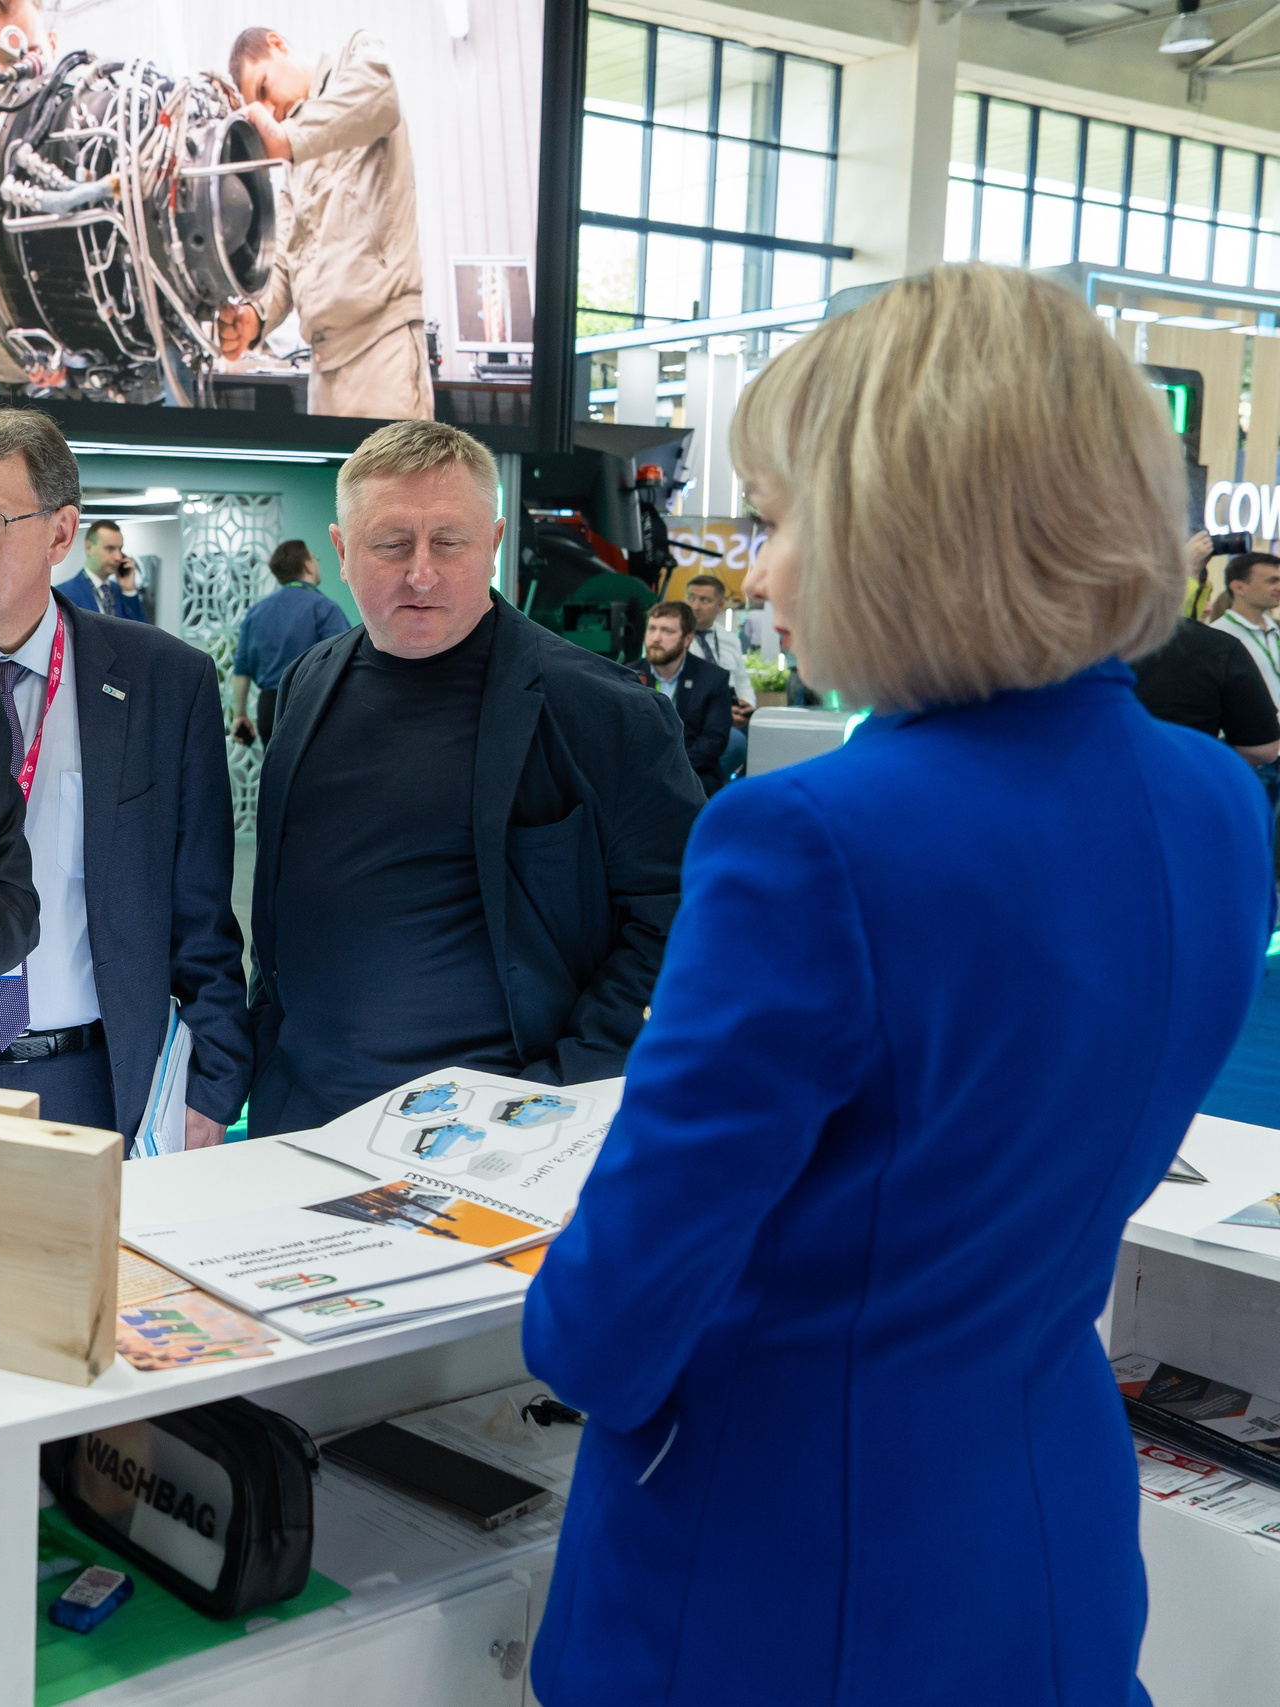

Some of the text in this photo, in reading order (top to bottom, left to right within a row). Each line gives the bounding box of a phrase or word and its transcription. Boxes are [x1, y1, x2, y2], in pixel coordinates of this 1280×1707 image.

[239, 1240, 352, 1265] ответственностью
[278, 1240, 305, 1250] дом
[330, 1240, 393, 1257] Общество
[226, 1255, 319, 1278] ограниченной
[87, 1433, 216, 1539] WASHBAG
